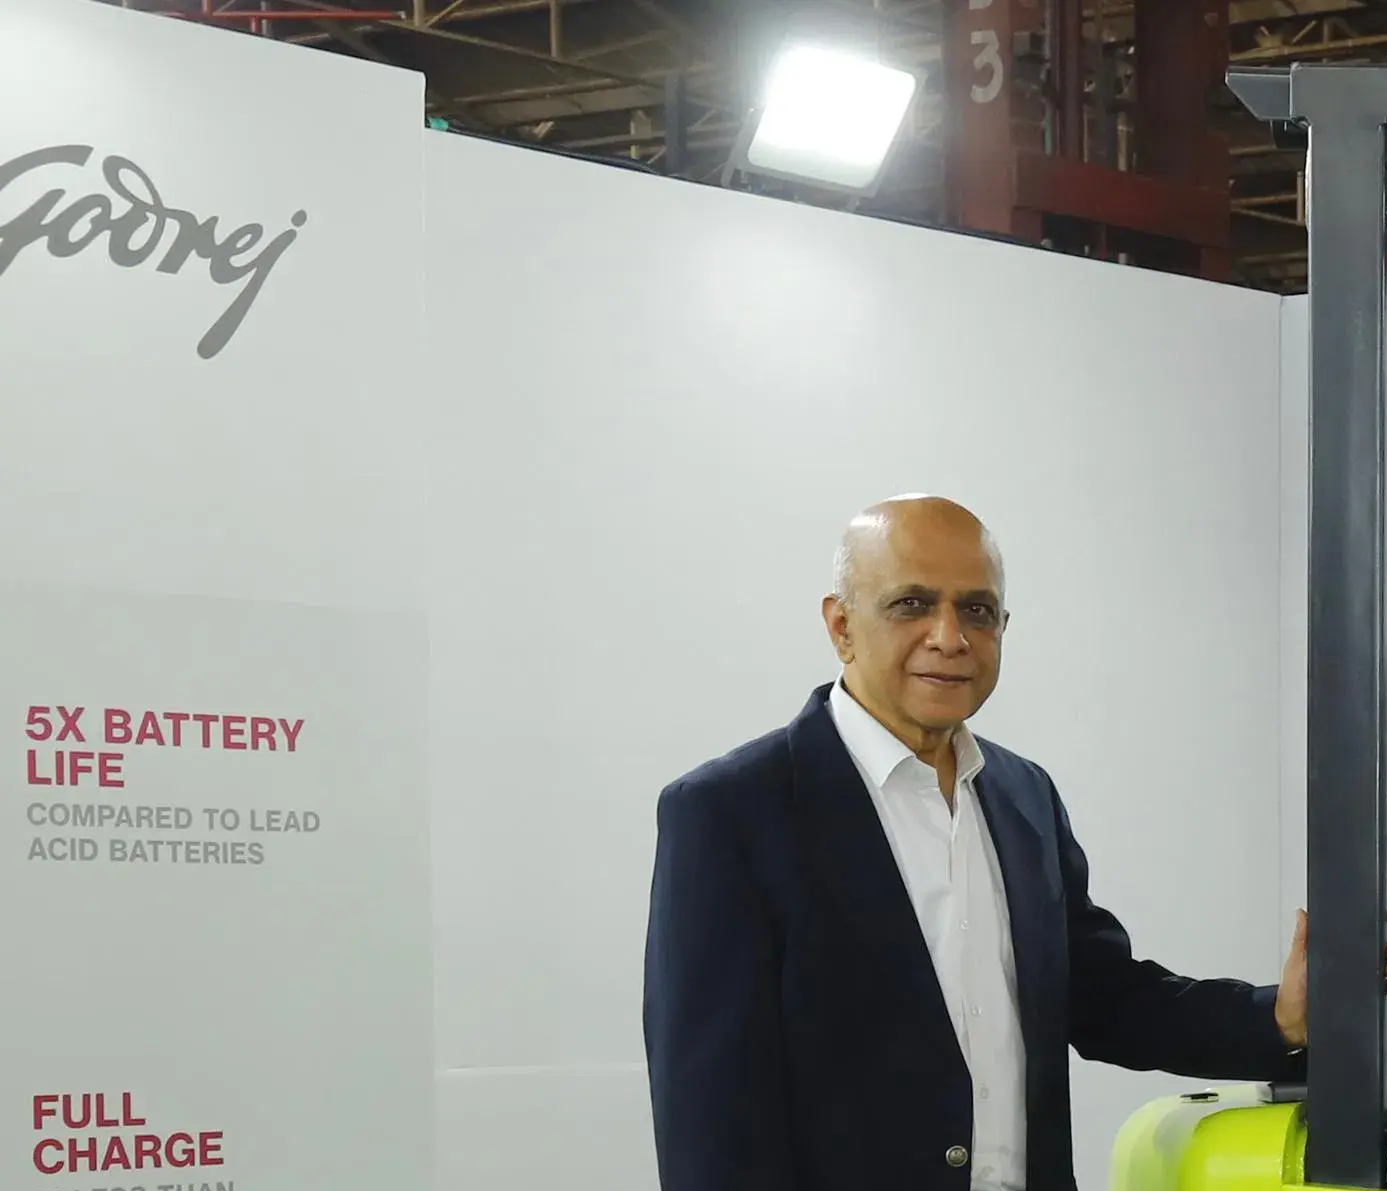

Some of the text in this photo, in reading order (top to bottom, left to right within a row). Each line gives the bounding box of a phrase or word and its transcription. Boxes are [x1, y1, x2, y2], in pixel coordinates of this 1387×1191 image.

[25, 705, 305, 752] 5X BATTERY
[26, 749, 125, 788] LIFE
[27, 802, 321, 833] COMPARED TO LEAD
[27, 836, 265, 865] ACID BATTERIES
[33, 1091, 146, 1130] FULL
[32, 1131, 225, 1175] CHARGE
